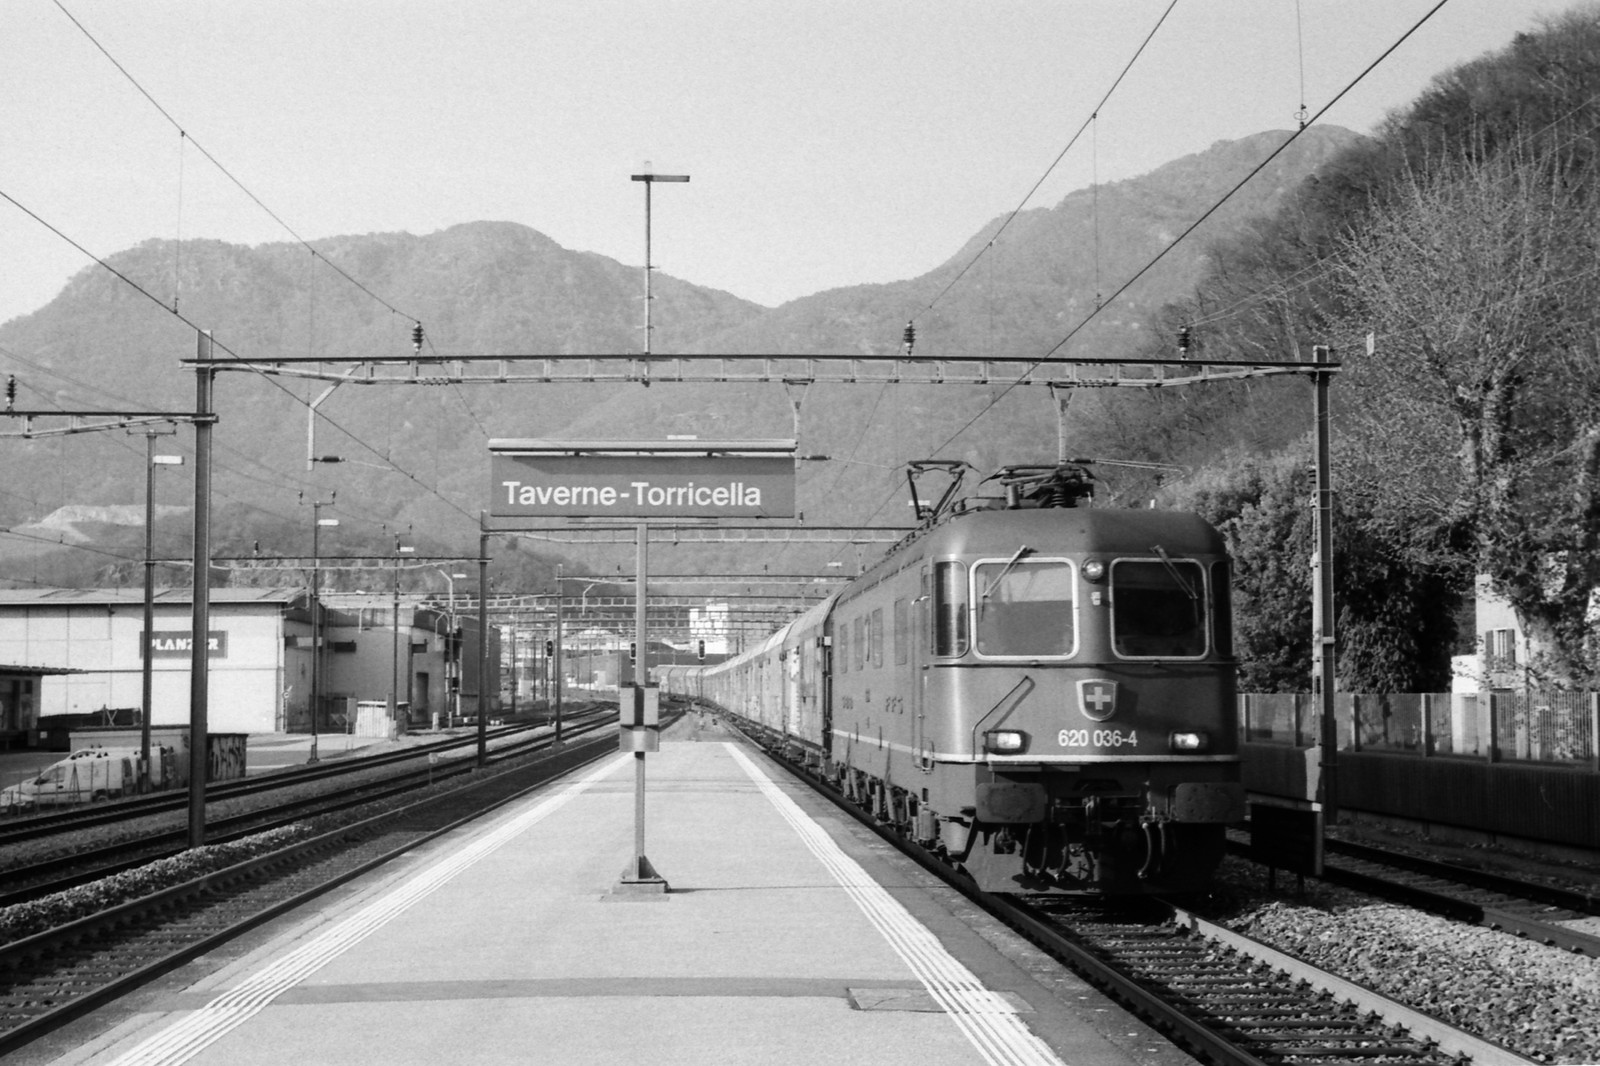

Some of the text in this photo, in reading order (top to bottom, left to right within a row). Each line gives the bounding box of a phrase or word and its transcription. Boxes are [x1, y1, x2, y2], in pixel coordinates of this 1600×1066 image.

[502, 481, 761, 506] Taverne-Torricella
[151, 638, 219, 651] LANR
[1058, 729, 1138, 747] 620 036-4
